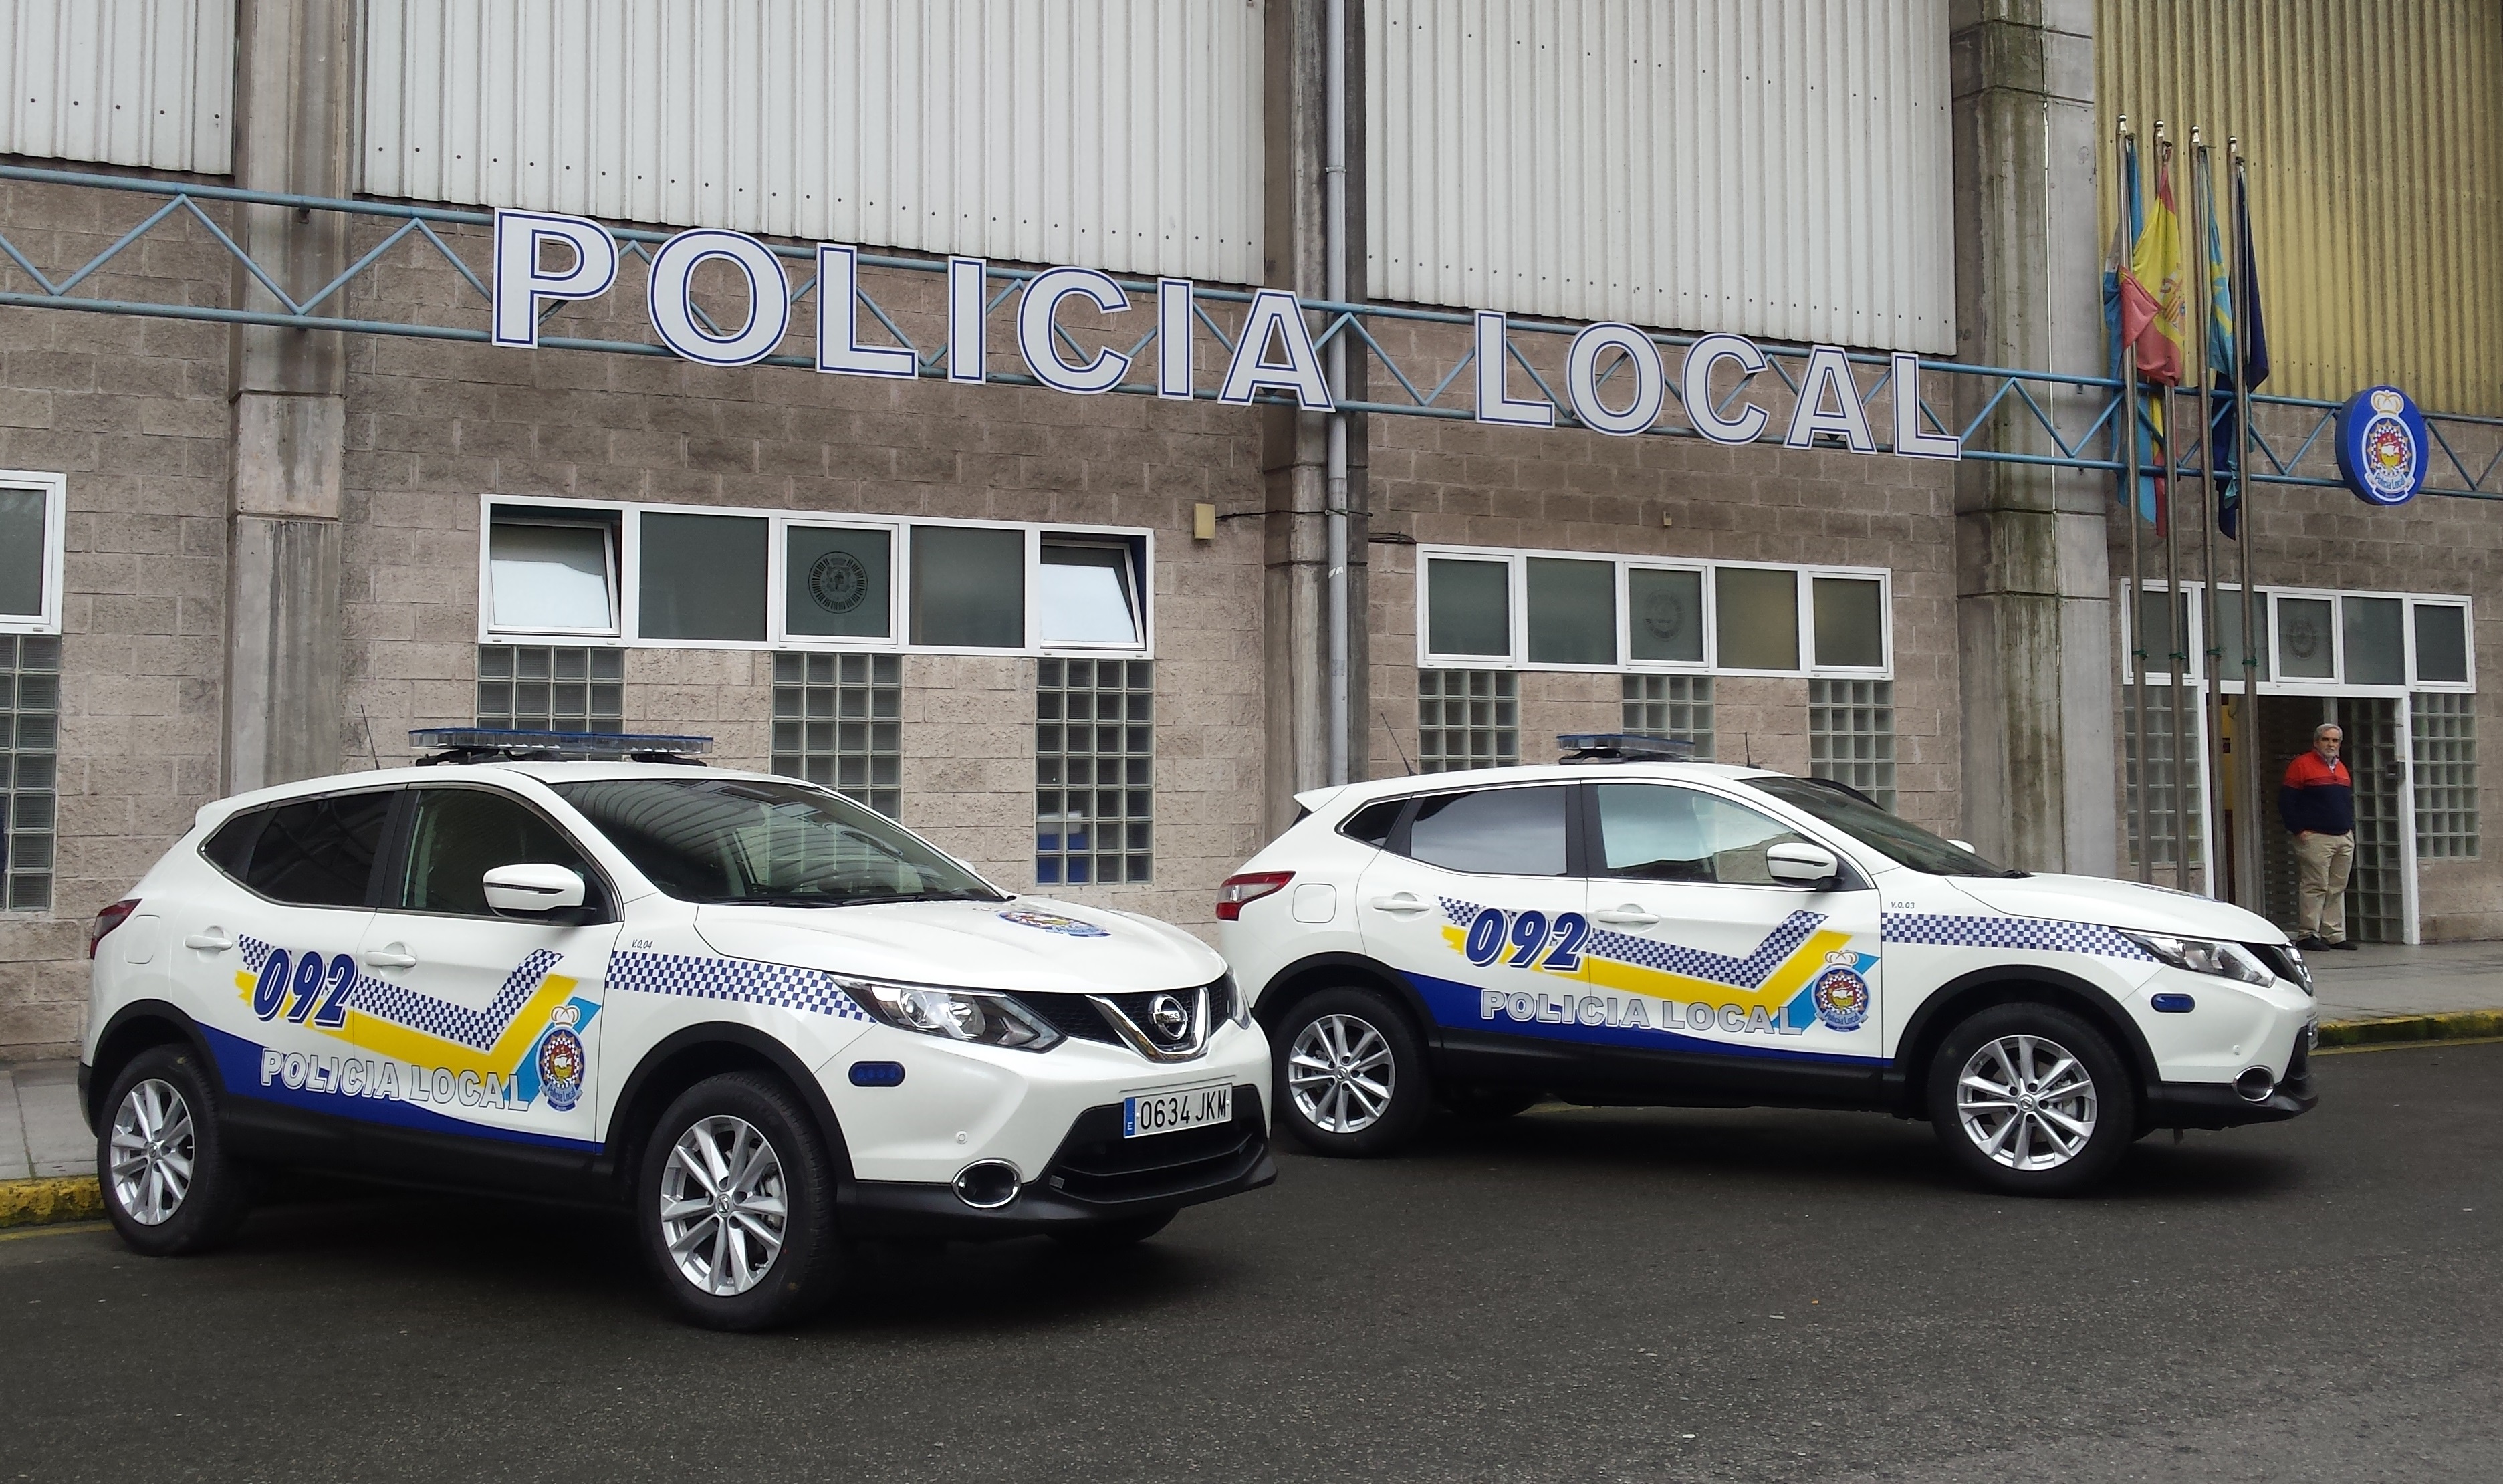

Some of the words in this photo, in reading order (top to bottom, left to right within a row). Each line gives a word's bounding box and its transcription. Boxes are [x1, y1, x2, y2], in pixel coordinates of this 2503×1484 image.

[491, 207, 1336, 412] POLICIA
[1473, 310, 1961, 461] LOCAL
[1464, 908, 1592, 971] 092
[251, 948, 361, 1028] 092
[1480, 989, 1651, 1028] POLICIA
[1662, 1000, 1803, 1035] LOCAL
[260, 1047, 401, 1101] POLICIA
[409, 1065, 529, 1112] LOCAL
[1141, 1096, 1190, 1130] 0634
[1195, 1089, 1227, 1122] JKM
[1127, 1122, 1133, 1131] E
